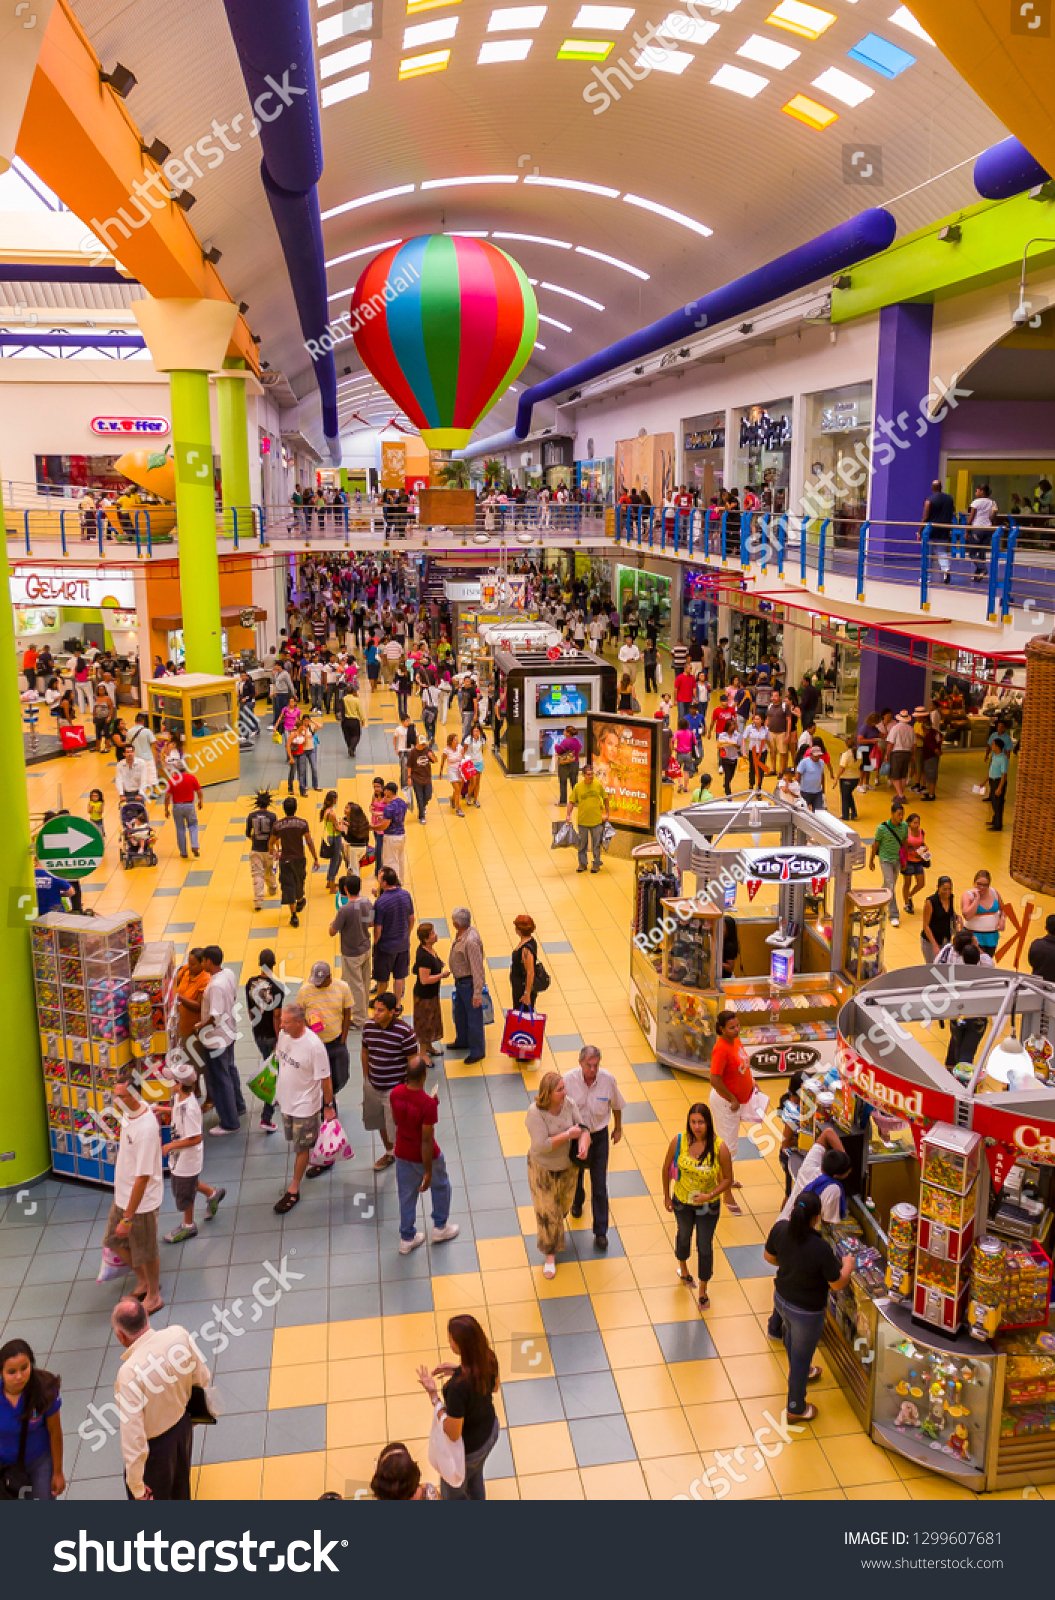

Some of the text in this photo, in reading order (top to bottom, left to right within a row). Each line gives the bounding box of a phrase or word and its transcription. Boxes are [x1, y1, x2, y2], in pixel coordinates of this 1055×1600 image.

[46, 859, 96, 868] SALIDA
[757, 860, 822, 873] Tie City
[755, 1051, 815, 1063] Tie City
[853, 1060, 923, 1117] Island
[995, 1153, 1004, 1183] SALE
